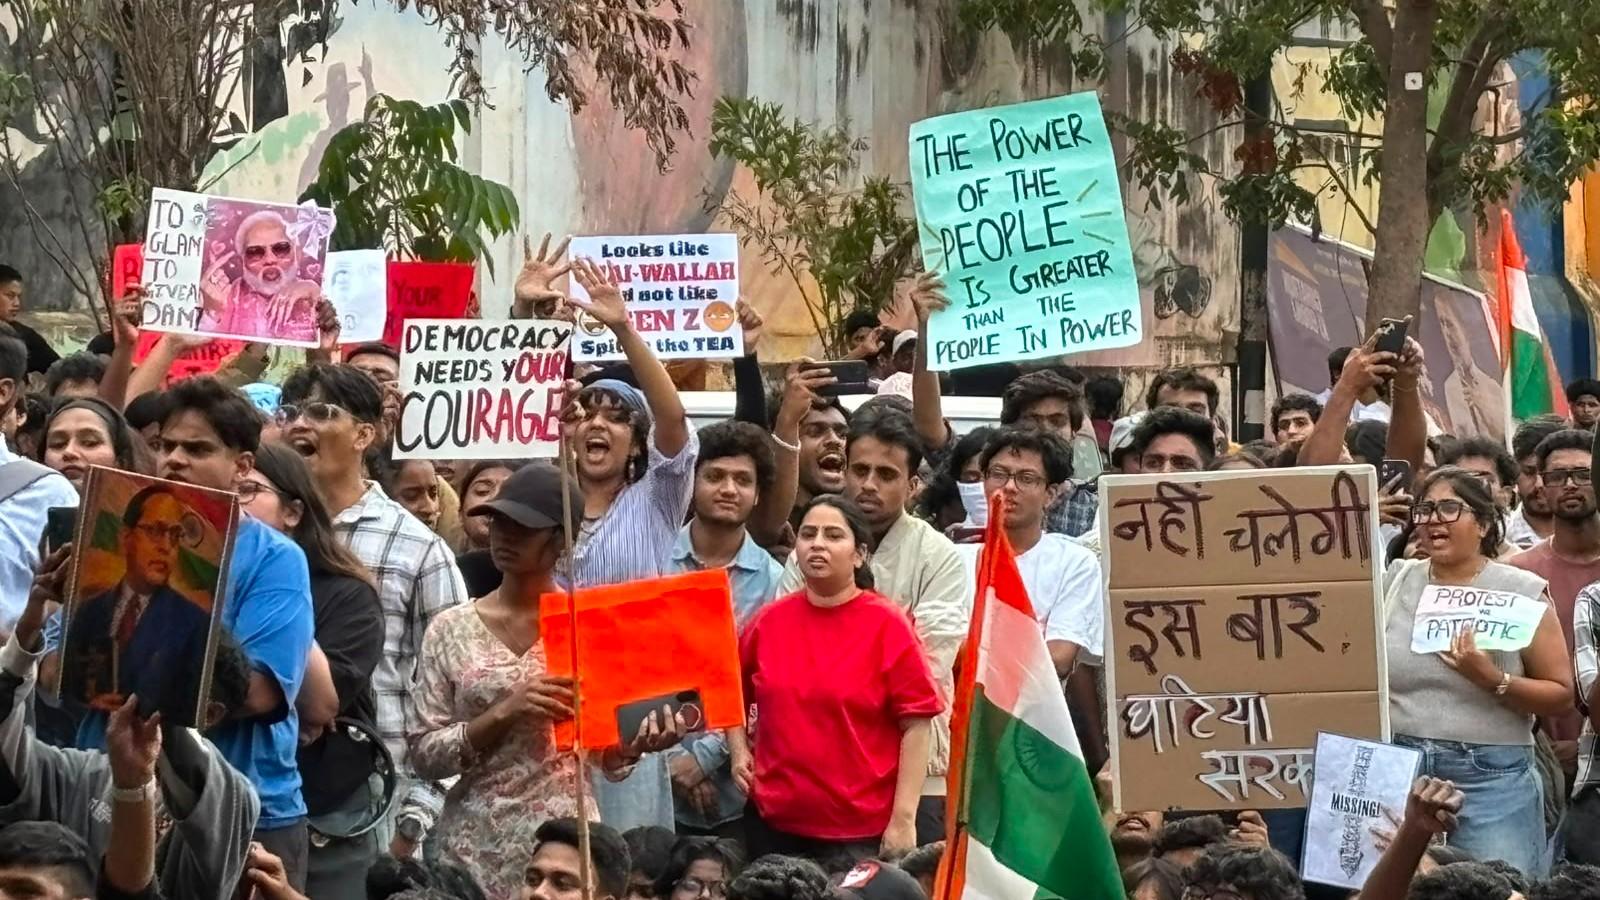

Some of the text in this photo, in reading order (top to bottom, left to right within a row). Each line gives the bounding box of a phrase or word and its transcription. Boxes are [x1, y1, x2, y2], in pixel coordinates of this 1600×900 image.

[916, 113, 1092, 178] THE POWER
[957, 167, 1061, 212] OF THE
[154, 199, 184, 229] TO
[601, 243, 664, 258] Looks
[941, 201, 1074, 271] PEOPLE
[145, 258, 177, 282] TO
[1010, 250, 1114, 295] GREATER
[639, 287, 674, 301] not
[962, 292, 1076, 331] THAN THE
[629, 308, 701, 332] EN Z
[936, 309, 1137, 364] PEOPLE IN POWER
[405, 324, 571, 354] DEMOCRACY
[656, 337, 689, 353] the
[693, 336, 734, 351] TEA
[414, 351, 566, 385] NEEDS YOUR
[395, 387, 563, 452] COURAGE
[1113, 470, 1370, 567] नहीं चलेगी
[1434, 588, 1518, 608] PROTEST
[1123, 599, 1206, 675] इस
[1122, 674, 1273, 754] घटिया
[1331, 793, 1381, 817] MISSING!
